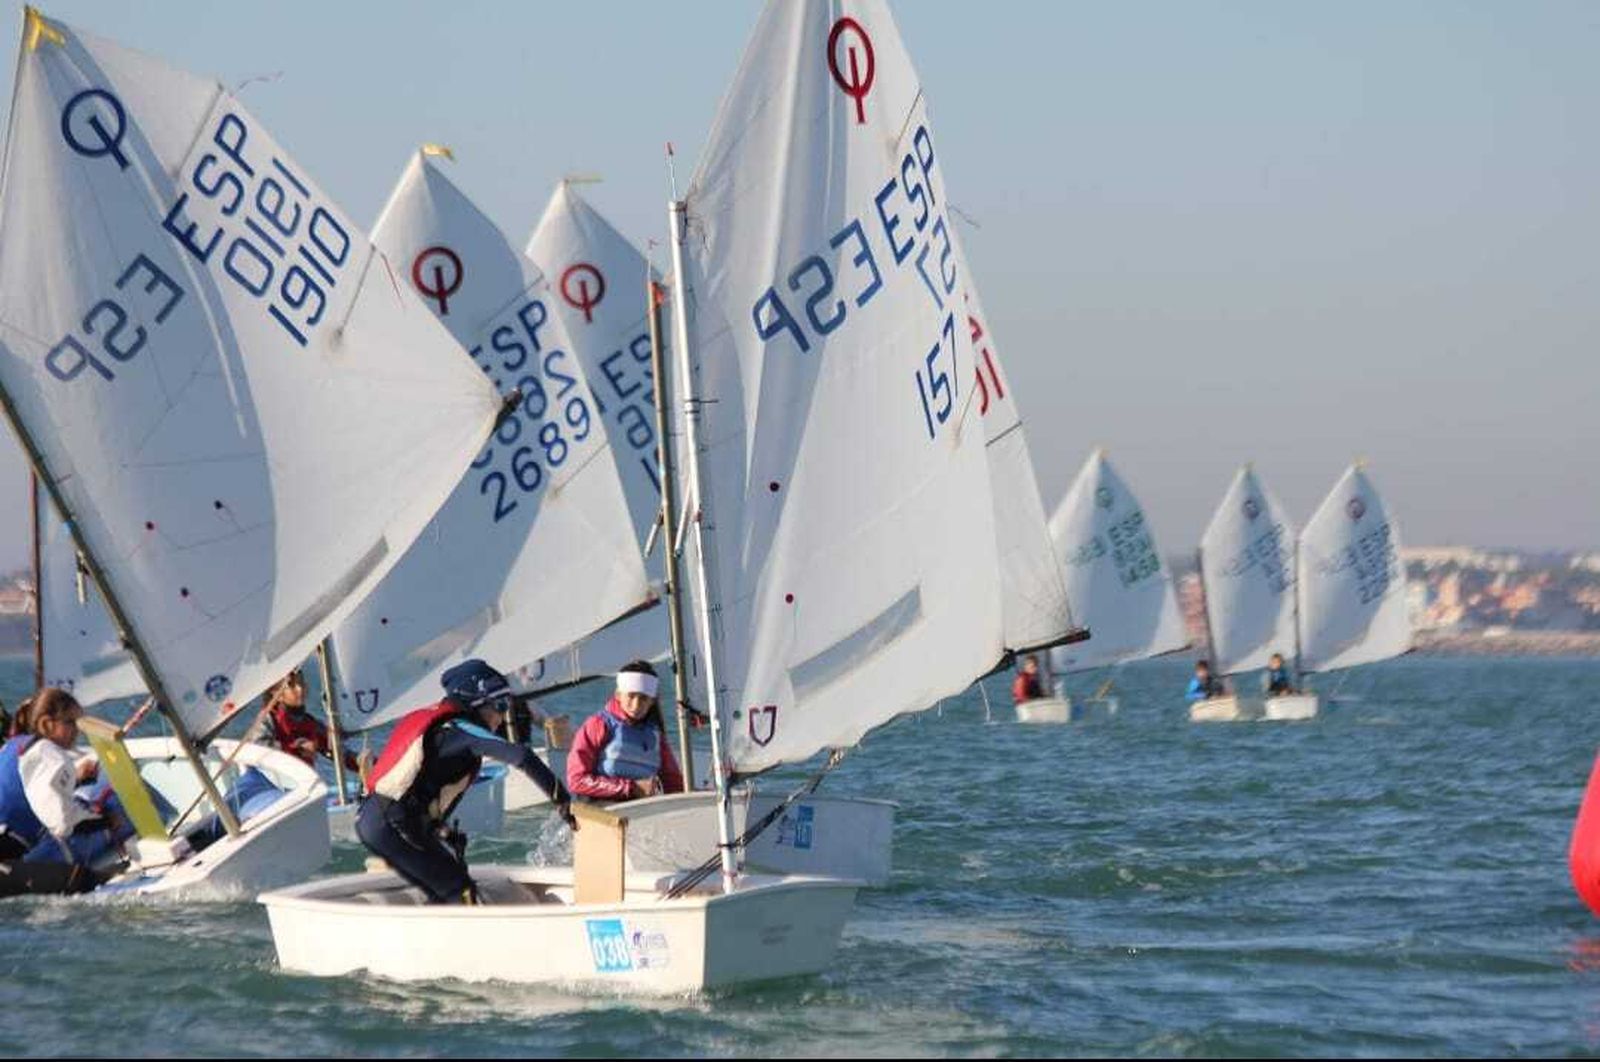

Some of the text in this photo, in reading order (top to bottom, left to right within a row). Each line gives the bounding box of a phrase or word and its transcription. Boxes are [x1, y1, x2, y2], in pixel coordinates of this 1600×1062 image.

[161, 112, 255, 264] ESP
[875, 125, 936, 266] ESP
[268, 206, 351, 347] 1910
[469, 300, 547, 388] SP
[915, 312, 958, 440] 157
[480, 397, 591, 523] 2689
